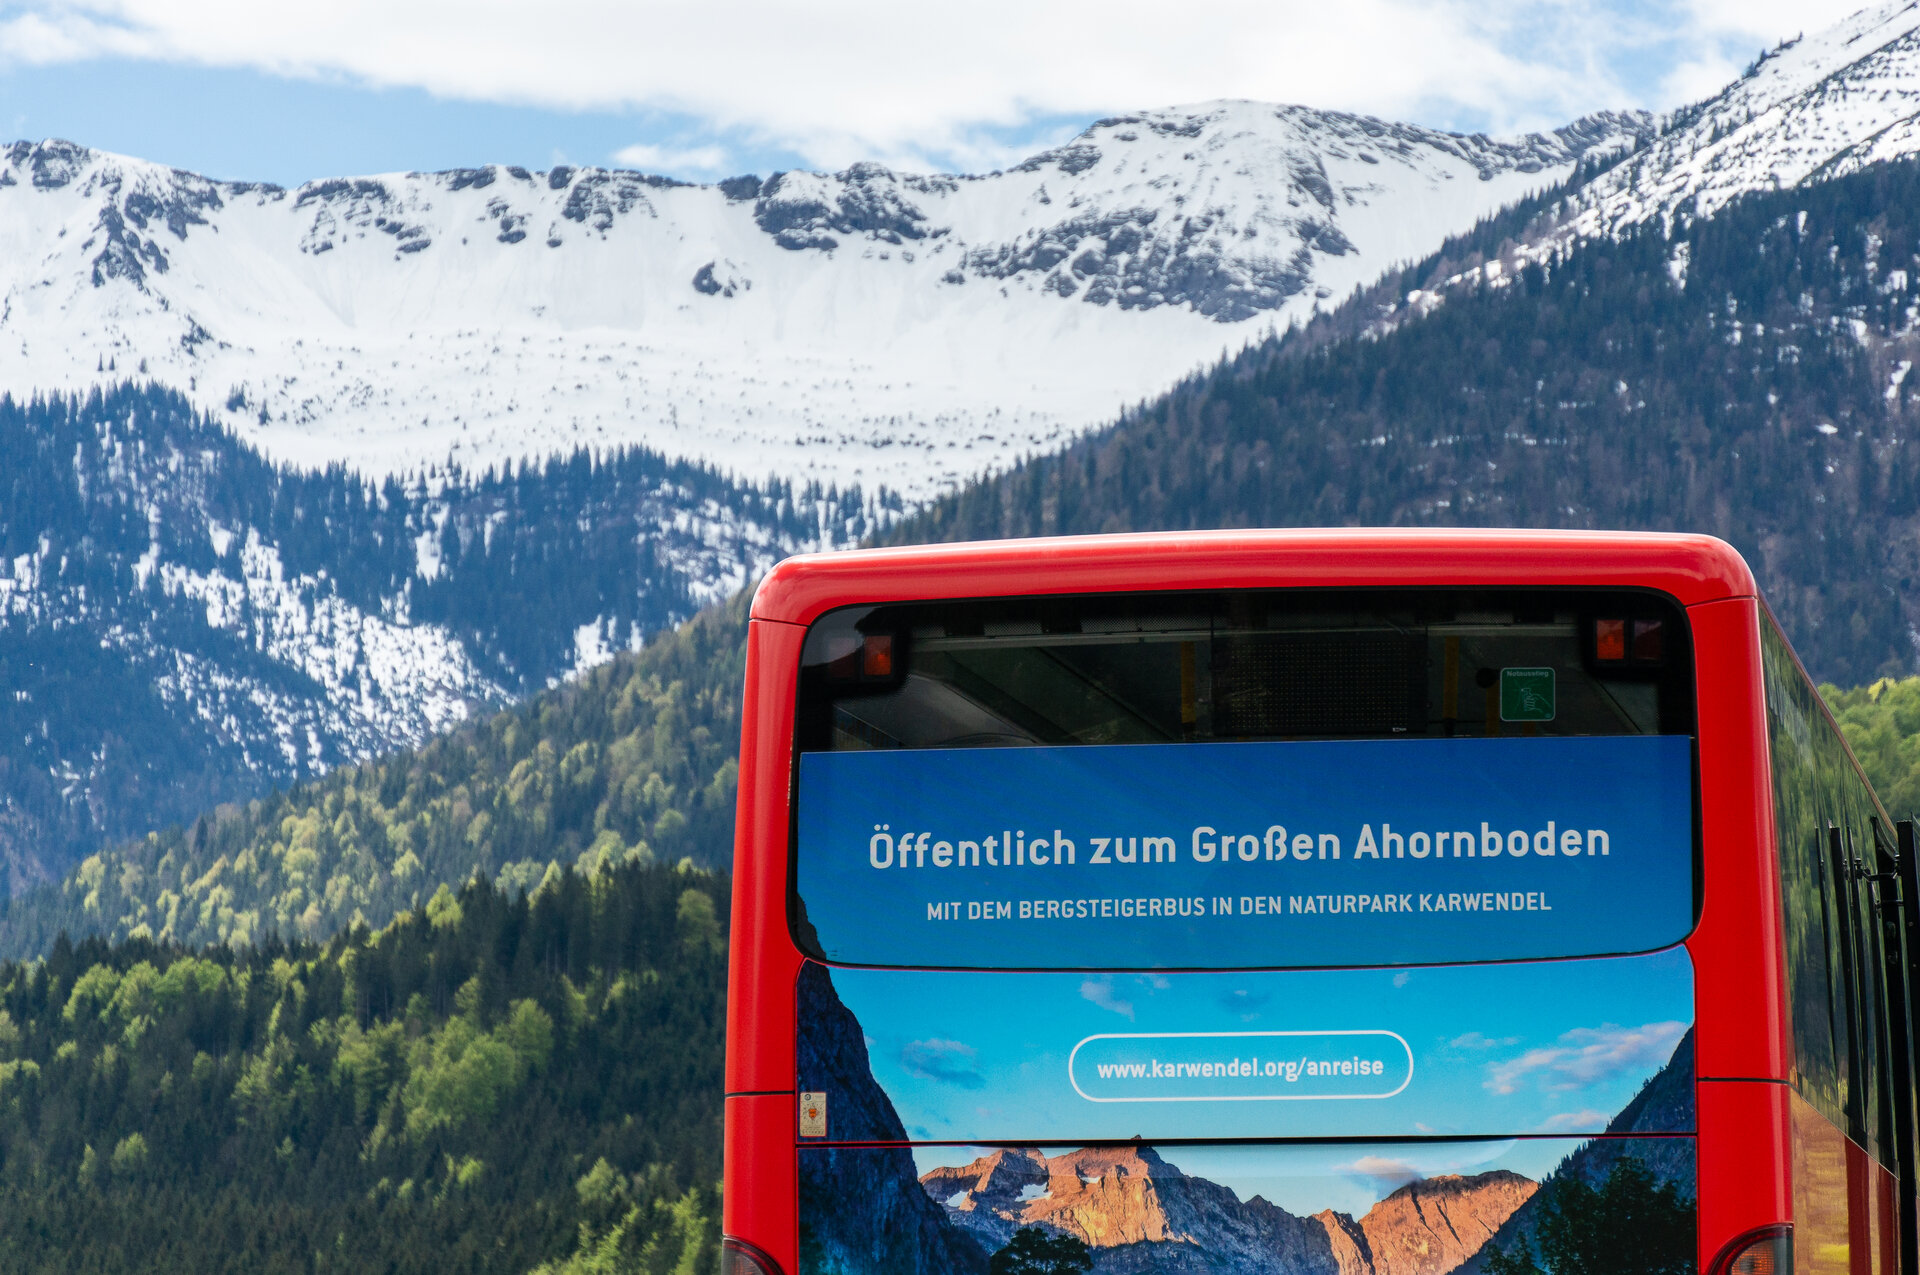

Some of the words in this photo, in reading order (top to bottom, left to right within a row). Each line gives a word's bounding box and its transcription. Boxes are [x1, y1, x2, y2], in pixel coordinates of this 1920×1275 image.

[1506, 670, 1549, 678] Notausstieg
[869, 823, 1076, 869] Öffentlich
[1089, 836, 1176, 864] zum
[1192, 825, 1341, 863] Großen
[1353, 820, 1610, 859] Ahornboden
[927, 902, 962, 921] MIT
[968, 901, 1011, 920] DEM
[1019, 897, 1205, 919] BERGSTEIGERBUS
[1212, 897, 1232, 915] IN
[1240, 896, 1282, 915] DEN
[1289, 894, 1413, 914] NATURPARK
[1419, 892, 1552, 912] KARWENDEL
[1097, 1055, 1384, 1083] www.karwendel.org/anreise
